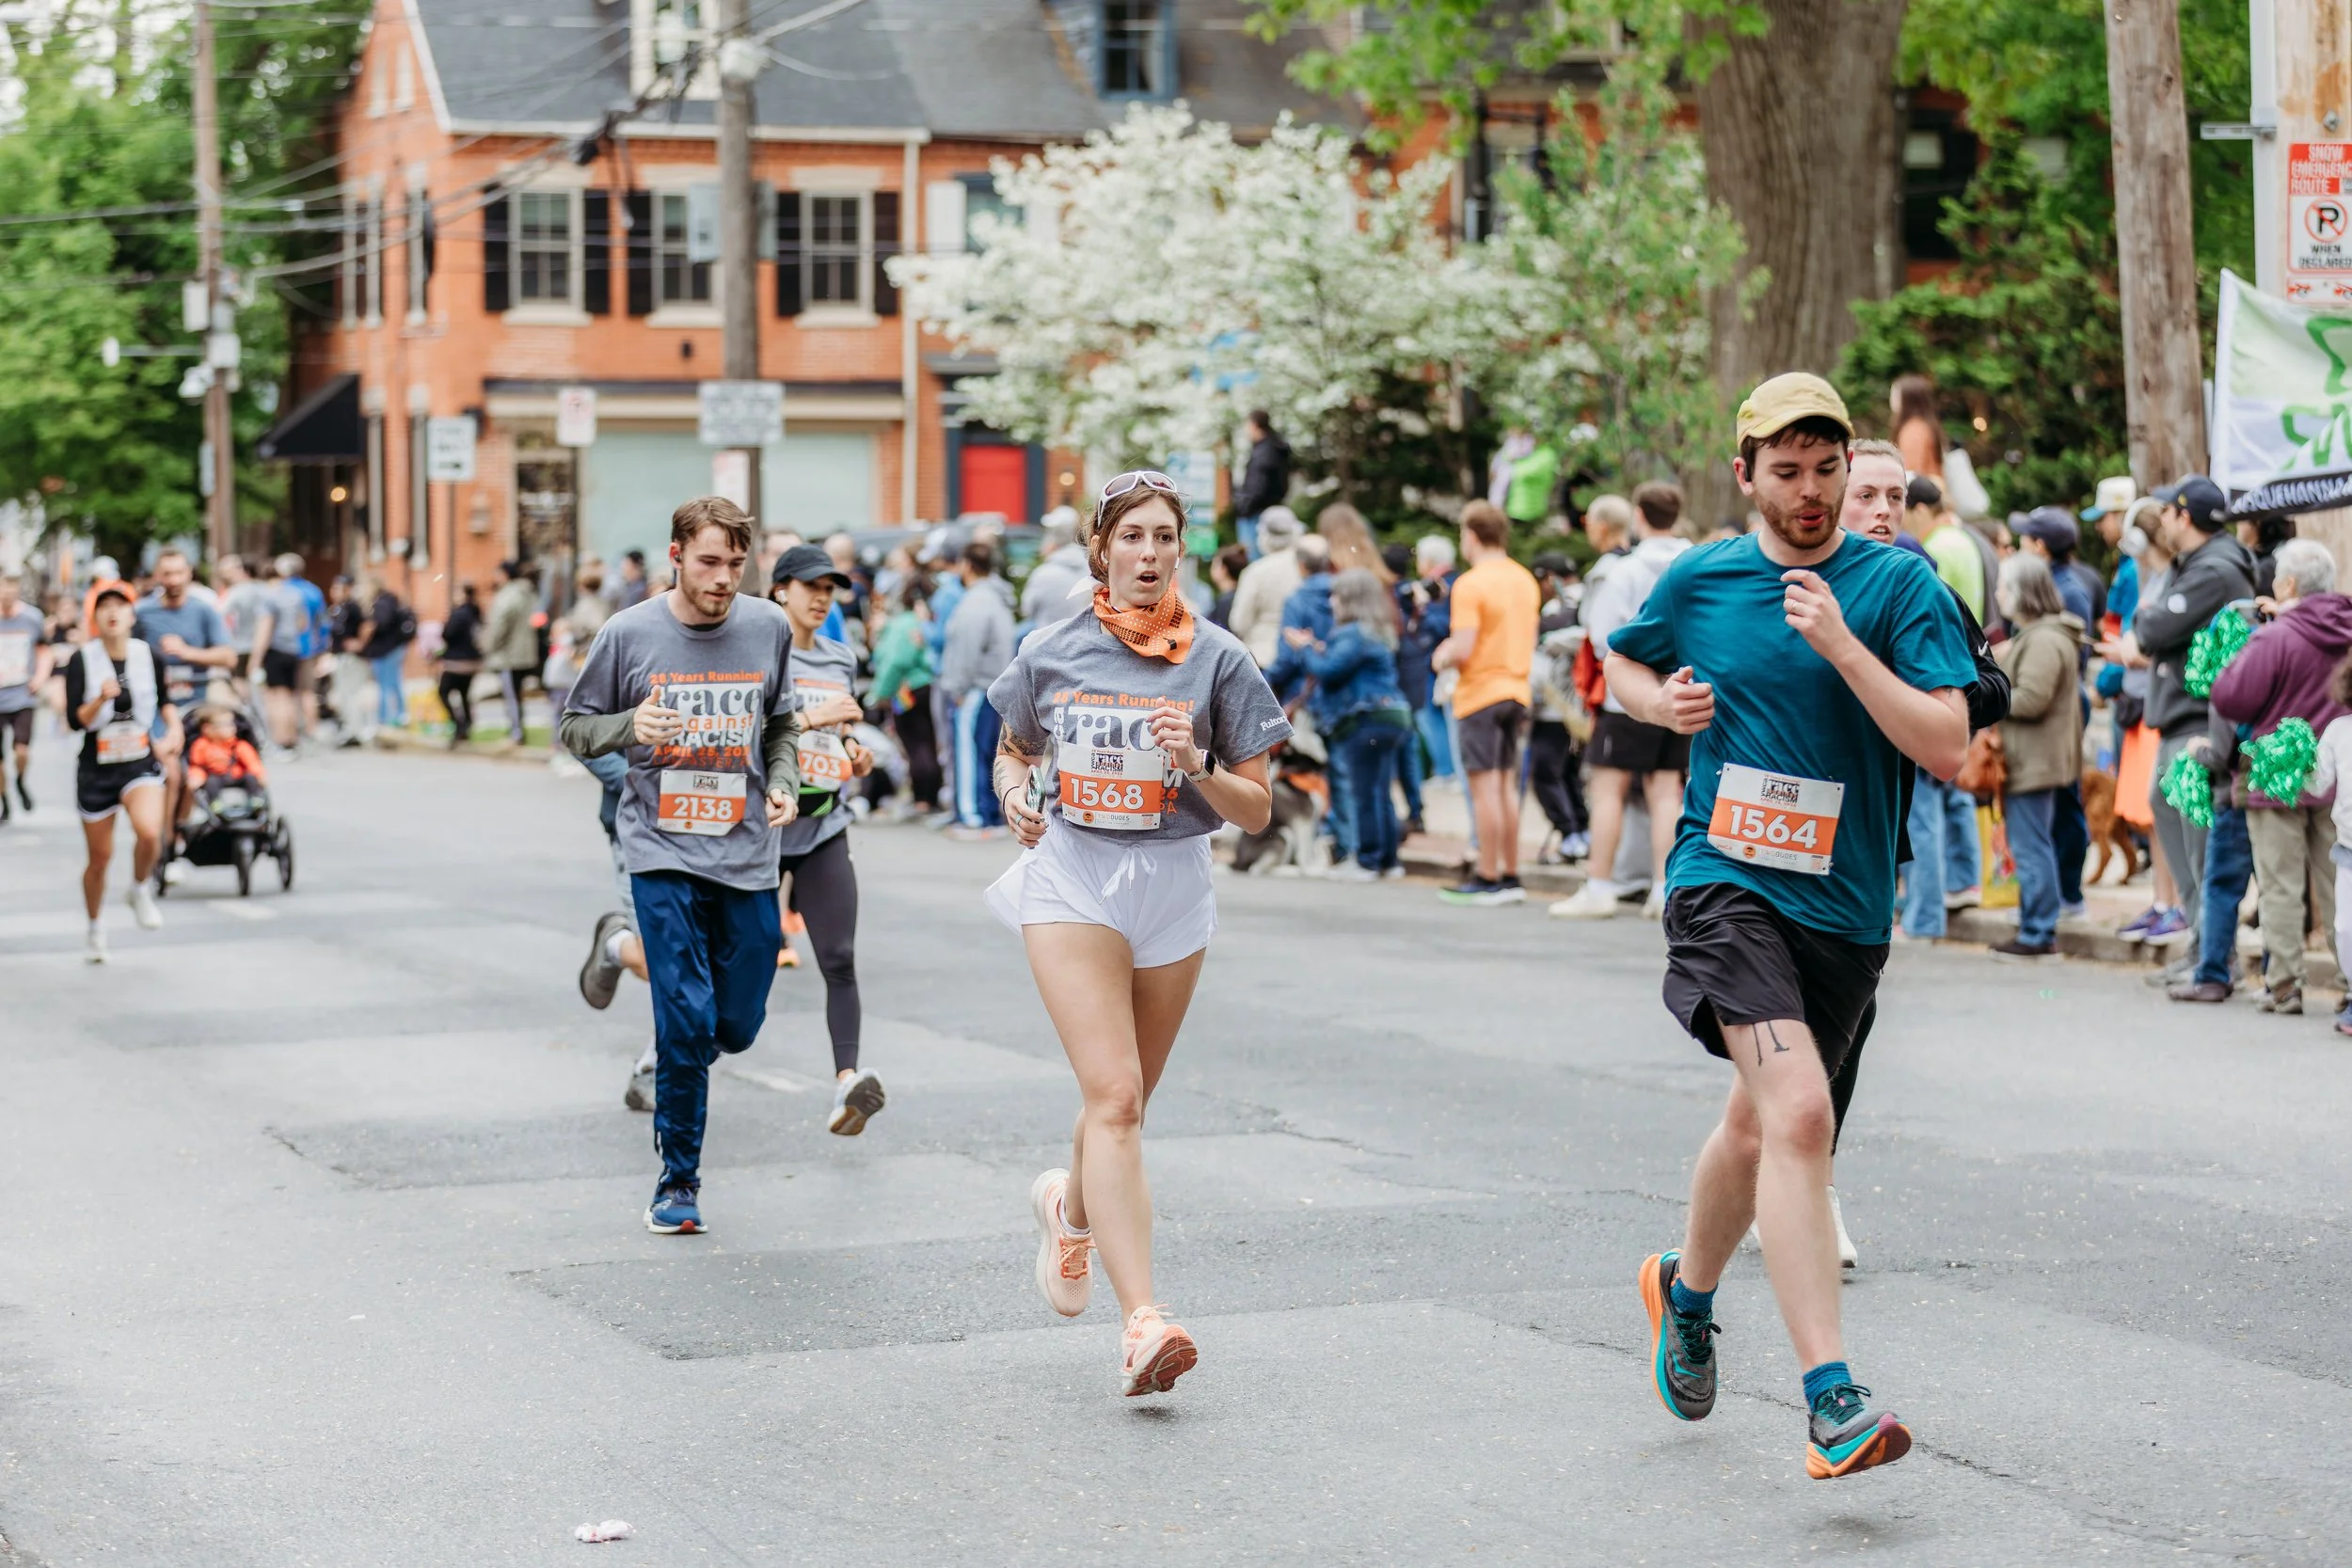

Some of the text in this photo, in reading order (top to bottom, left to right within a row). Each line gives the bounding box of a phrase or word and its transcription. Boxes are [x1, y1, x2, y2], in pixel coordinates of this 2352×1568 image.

[2309, 144, 2344, 161] SNOW
[2292, 178, 2328, 196] ROUTE
[2311, 244, 2341, 254] WHEN
[670, 672, 705, 684] Years
[707, 669, 765, 683] Running!
[1072, 691, 1114, 705] Years
[1118, 693, 1195, 713] Runnng!
[1071, 777, 1144, 810] 1568
[673, 795, 733, 821] 2138
[1730, 804, 1818, 849] 1564
